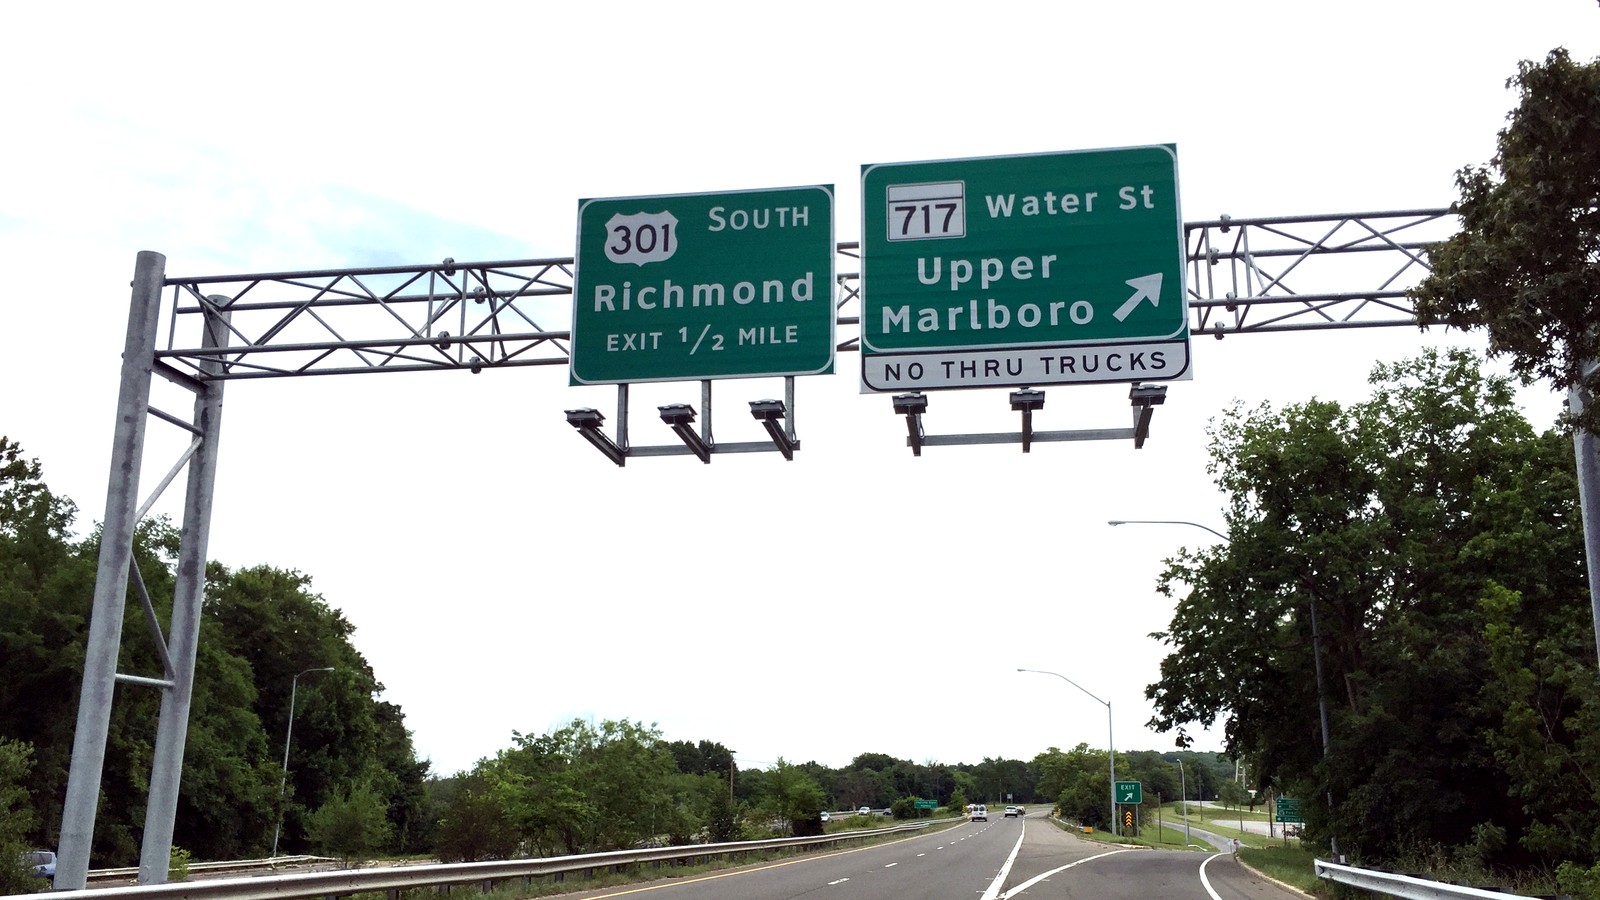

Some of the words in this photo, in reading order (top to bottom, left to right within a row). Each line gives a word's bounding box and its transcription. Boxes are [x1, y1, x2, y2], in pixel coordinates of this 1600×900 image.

[985, 191, 1098, 218] Water
[1119, 185, 1154, 210] St
[708, 206, 809, 232] SOUTH
[894, 202, 957, 236] 717
[610, 223, 670, 256] 301
[917, 254, 1057, 291] Upper
[594, 271, 813, 312] Richmond
[882, 298, 1094, 334] Marlboro
[607, 332, 663, 352] EXIT
[678, 324, 724, 355] 1/2
[739, 325, 798, 346] MILE
[884, 361, 925, 382] NO
[940, 357, 1024, 379] THRU
[1039, 351, 1167, 375] TRUCKS
